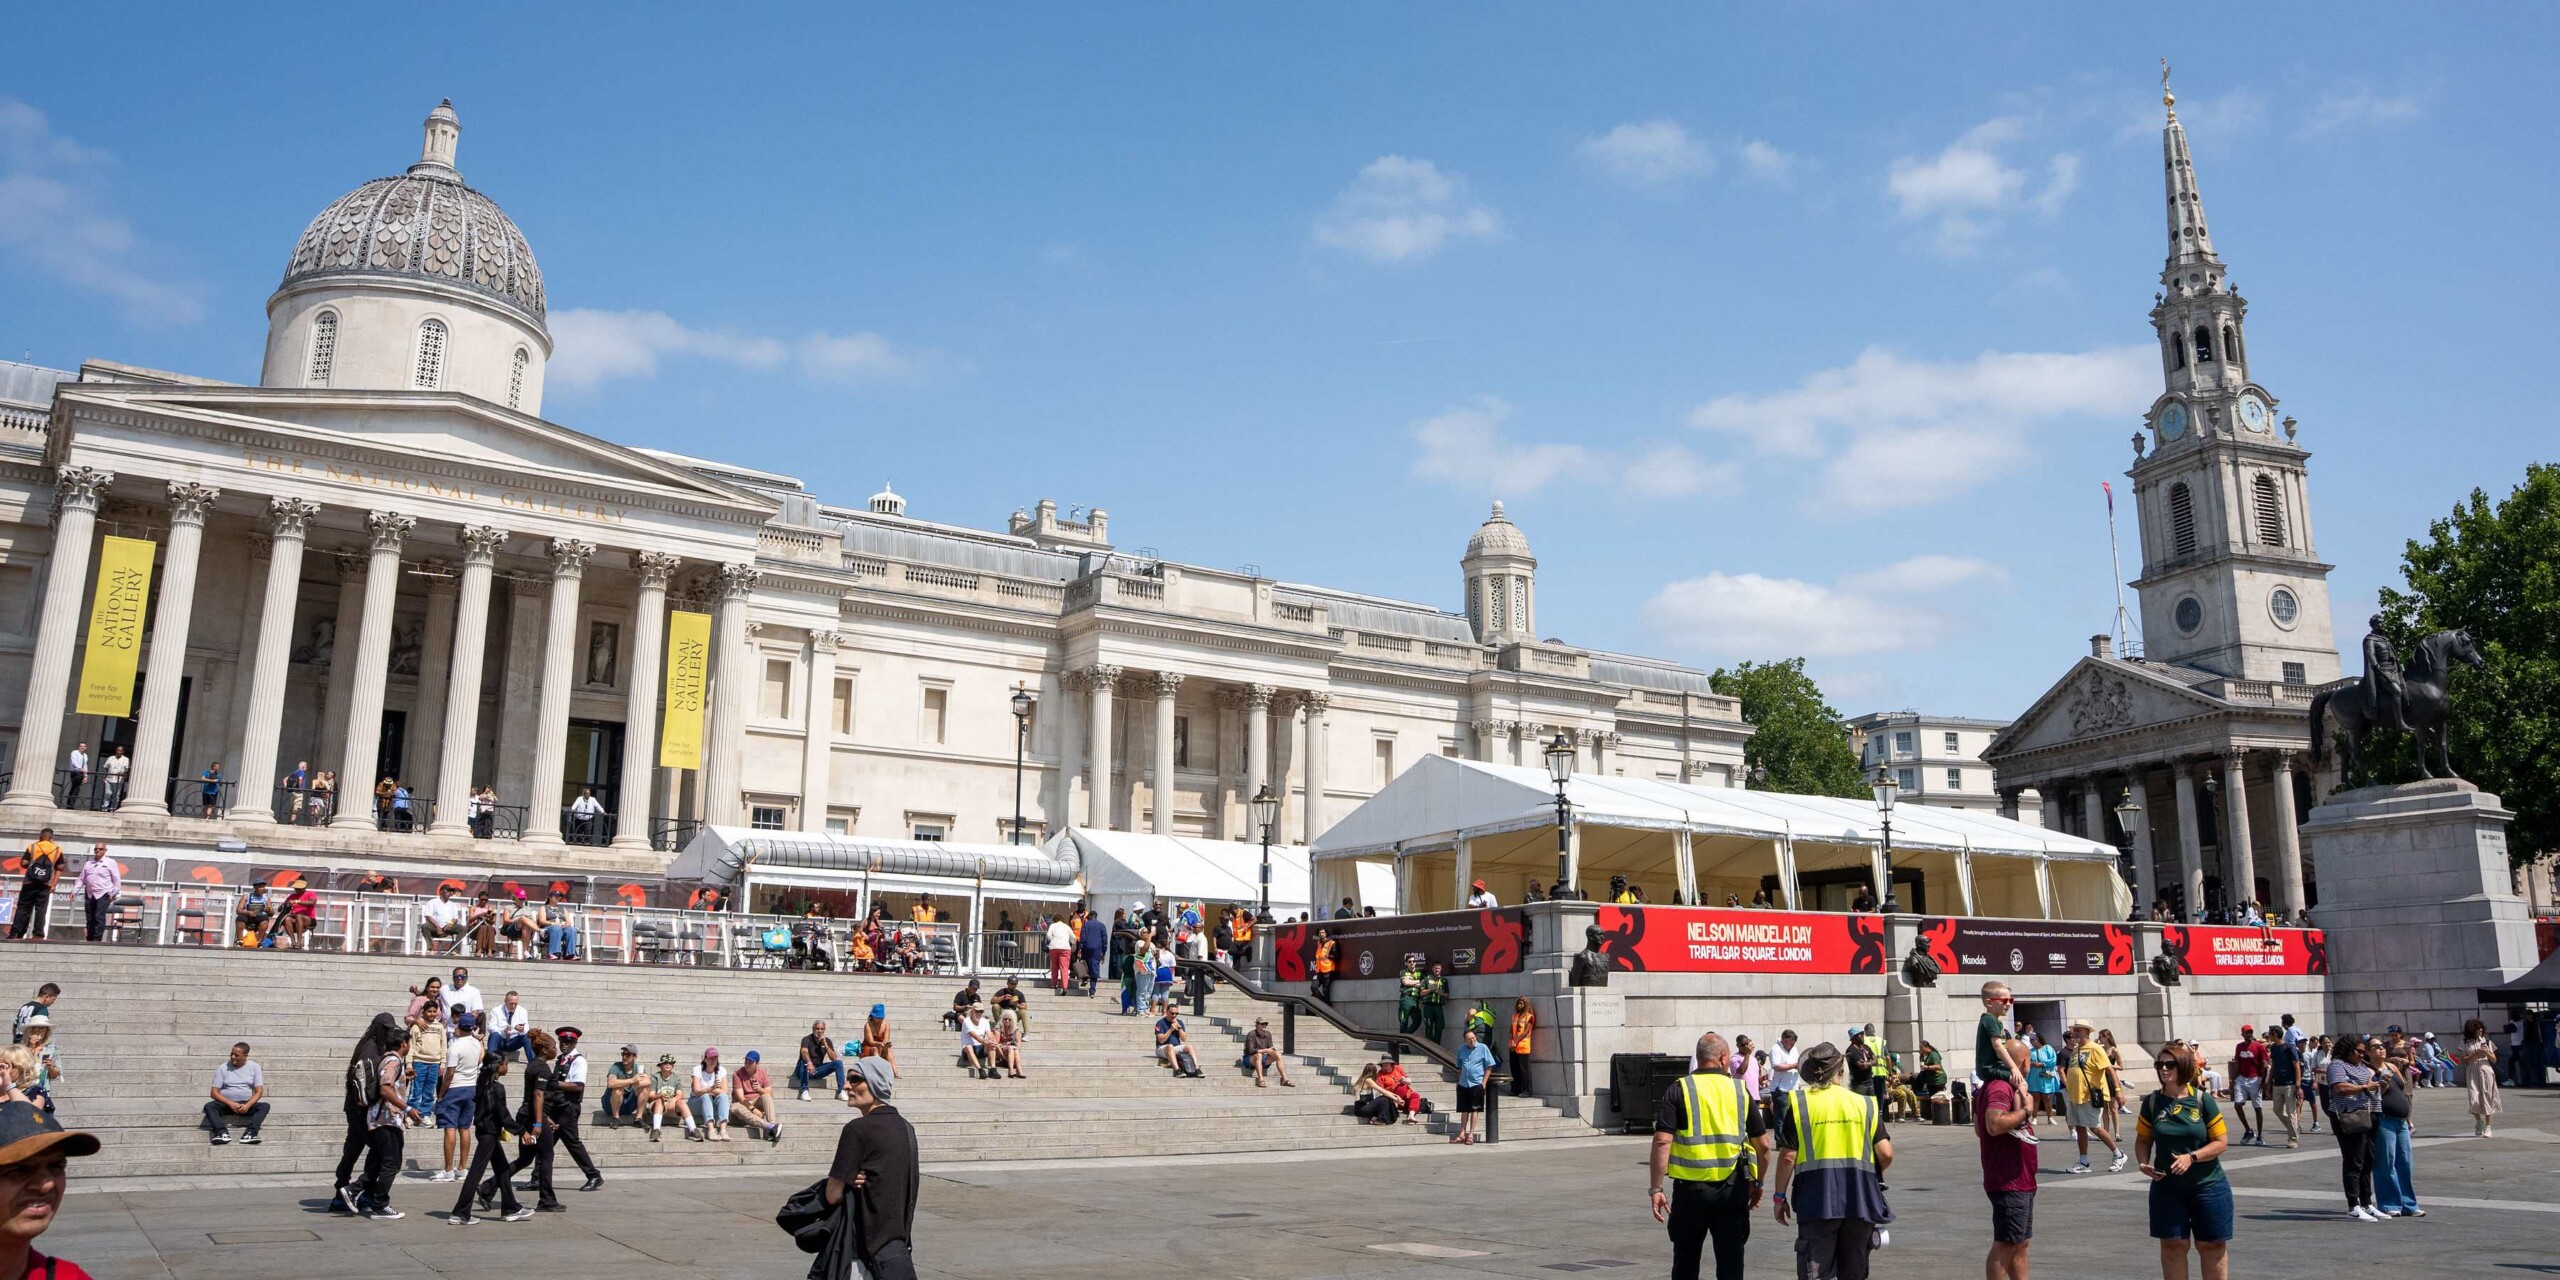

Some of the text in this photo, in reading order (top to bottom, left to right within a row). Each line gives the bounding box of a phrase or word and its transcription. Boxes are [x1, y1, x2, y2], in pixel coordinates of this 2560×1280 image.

[244, 450, 628, 524] THE NATIONAL GALLERY
[101, 566, 127, 648] NATIONAL
[117, 568, 143, 650] GALLERY
[96, 610, 105, 625] THE
[674, 638, 691, 710] NATIONAL
[686, 639, 703, 712] GALLERY
[90, 683, 119, 692] Free for
[88, 692, 122, 702] everyone
[668, 748, 694, 758] everyone
[1687, 922, 1812, 944] NELSON MANDELA DAY
[1688, 944, 1741, 960] TRAFALGAR
[1778, 947, 1812, 961] LONDON
[2213, 938, 2240, 952] NELSON
[1962, 954, 1987, 965] Nando's
[2214, 954, 2245, 966] TRAFALGAR
[2265, 955, 2285, 966] LONDON
